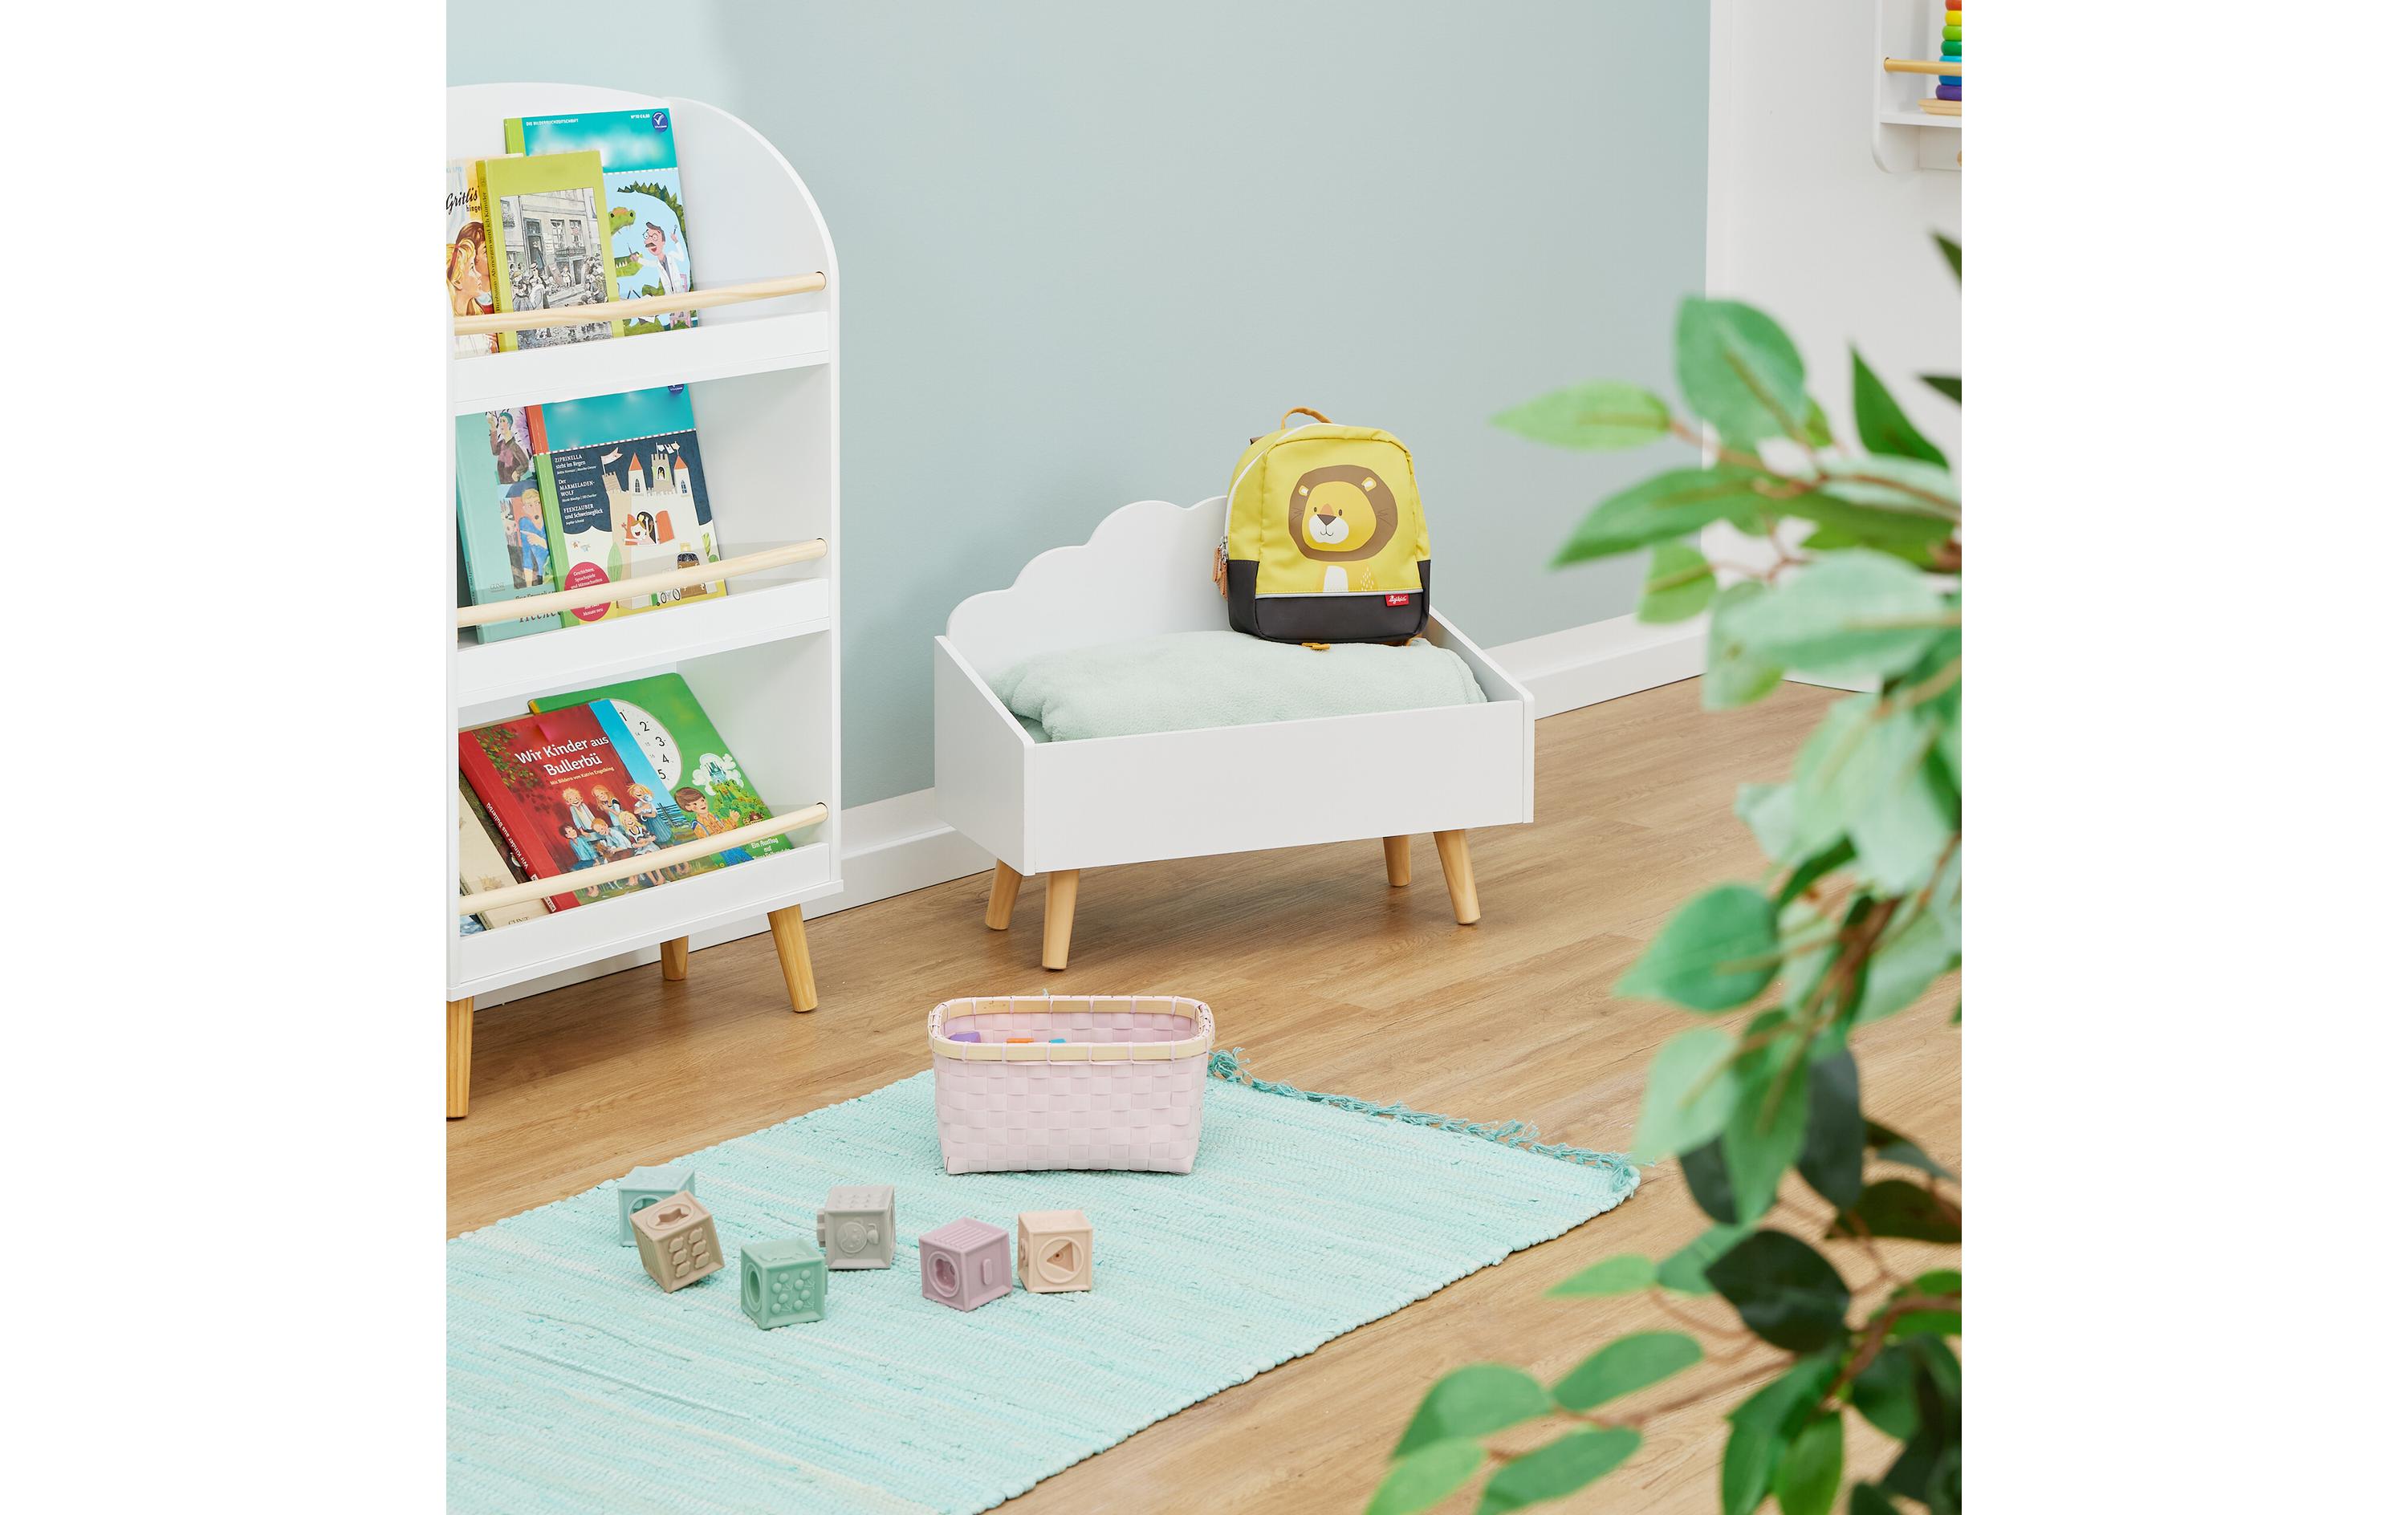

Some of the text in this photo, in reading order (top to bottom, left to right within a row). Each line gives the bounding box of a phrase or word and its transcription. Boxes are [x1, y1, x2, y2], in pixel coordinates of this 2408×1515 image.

[446, 187, 478, 215] Gritlis
[559, 480, 595, 490] MARMELADEN-
[563, 503, 594, 514] FEENZAUBER
[574, 508, 604, 517] Schweineglück
[639, 721, 650, 732] 2
[655, 736, 665, 747] 3
[515, 736, 610, 765] Wir Kinder aus
[543, 752, 603, 776] Bullerbü
[662, 753, 669, 764] 4
[657, 769, 666, 780] 5
[486, 802, 529, 870] Wir Kinder aus Bullerbü
[760, 838, 779, 847] Ausflug
